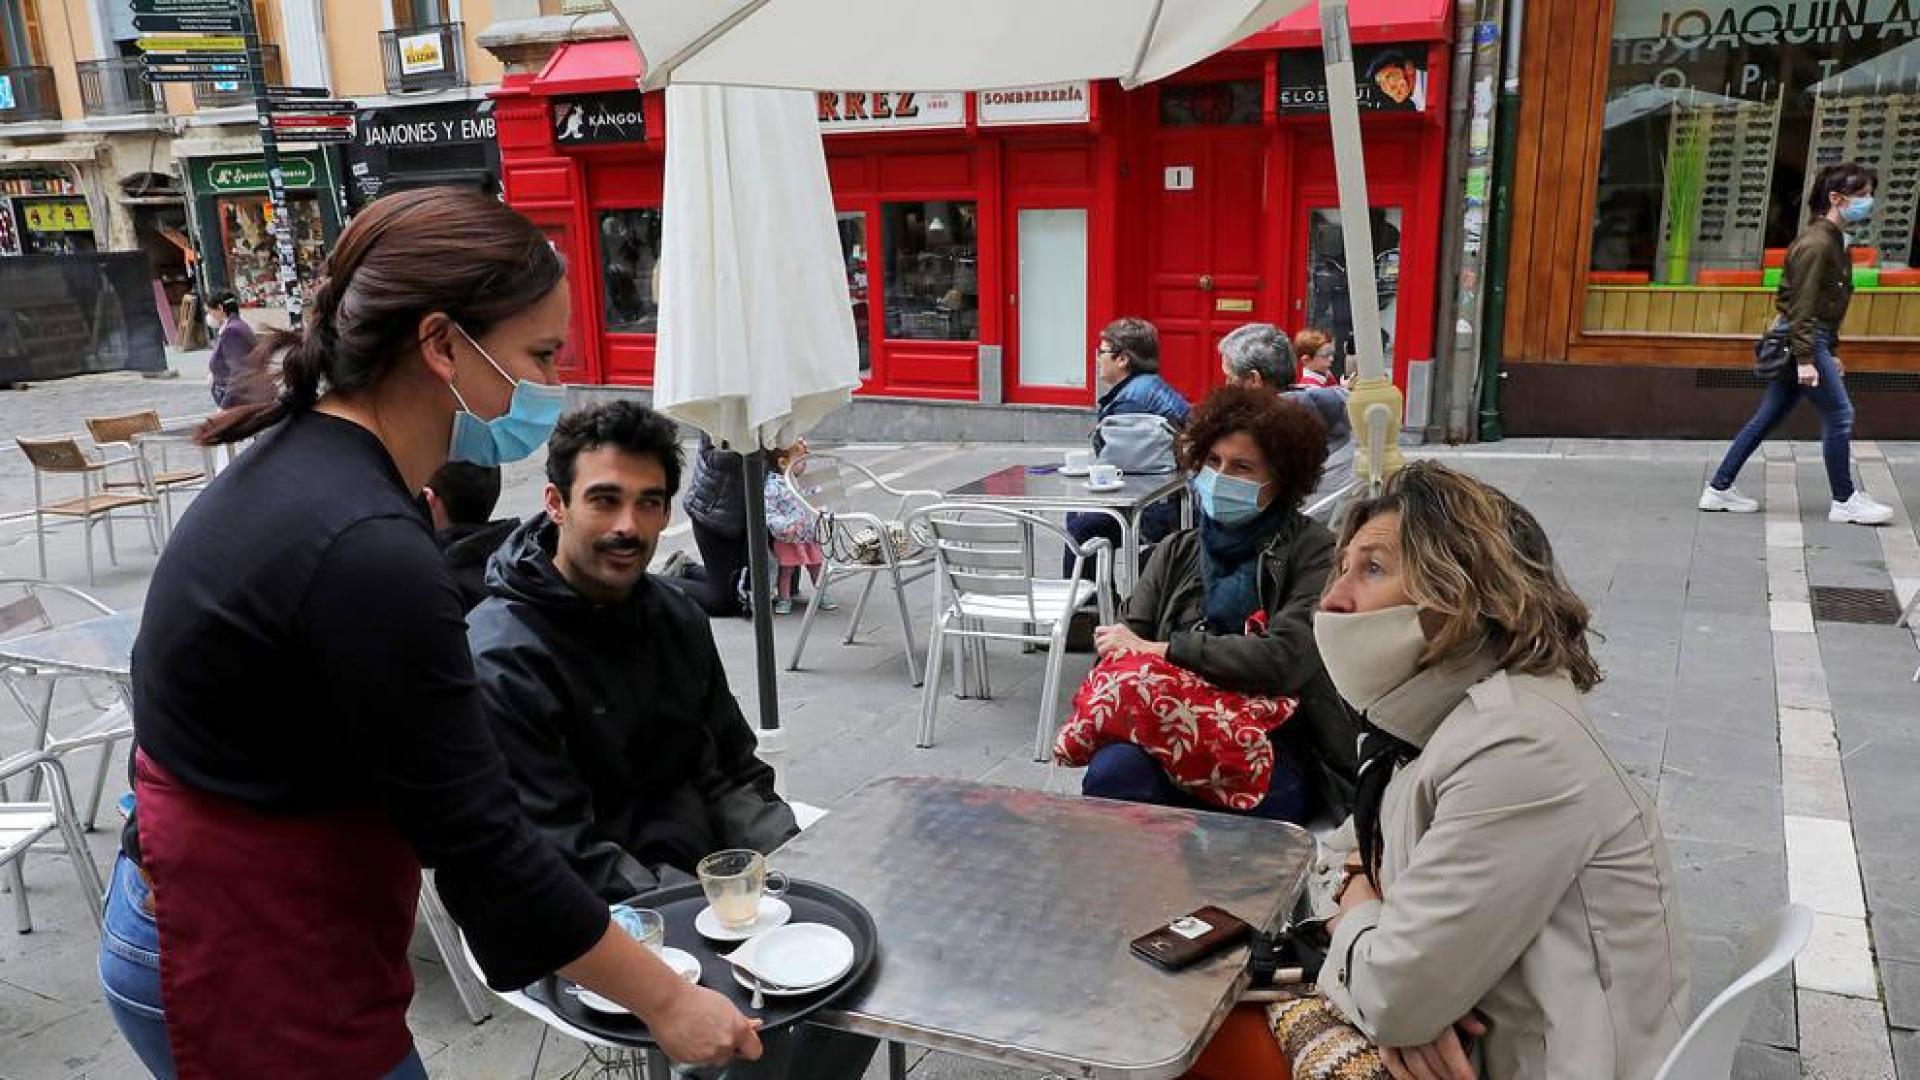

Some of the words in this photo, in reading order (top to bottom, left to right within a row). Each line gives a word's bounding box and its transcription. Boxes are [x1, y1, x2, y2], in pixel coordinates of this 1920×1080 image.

[1652, 0, 1866, 50] JOAQUIN
[588, 112, 644, 127] KANGOL
[365, 122, 437, 146] JAMONES
[442, 121, 454, 140] Y
